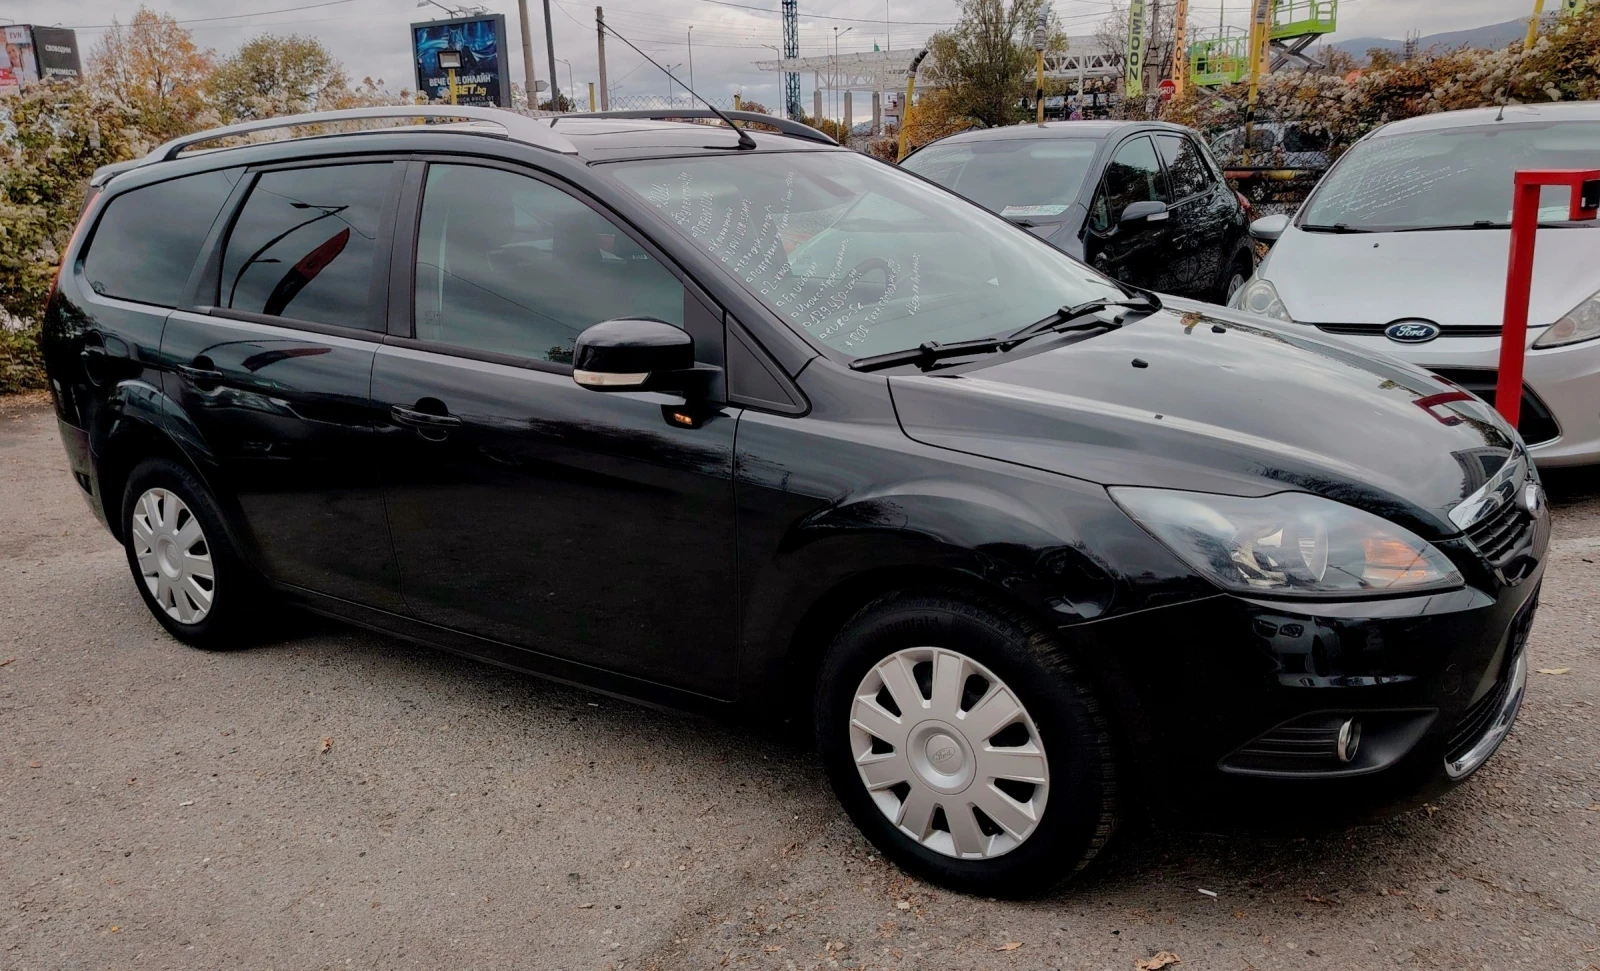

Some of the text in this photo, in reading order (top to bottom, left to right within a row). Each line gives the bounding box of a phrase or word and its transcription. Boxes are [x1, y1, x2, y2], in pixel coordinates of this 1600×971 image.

[9, 31, 22, 39] EVN
[45, 44, 72, 54] СВОБОДНИ
[429, 77, 446, 87] ВЕЧЕ
[462, 73, 491, 84] ОНЛАЙН
[1396, 324, 1428, 336] Ford
